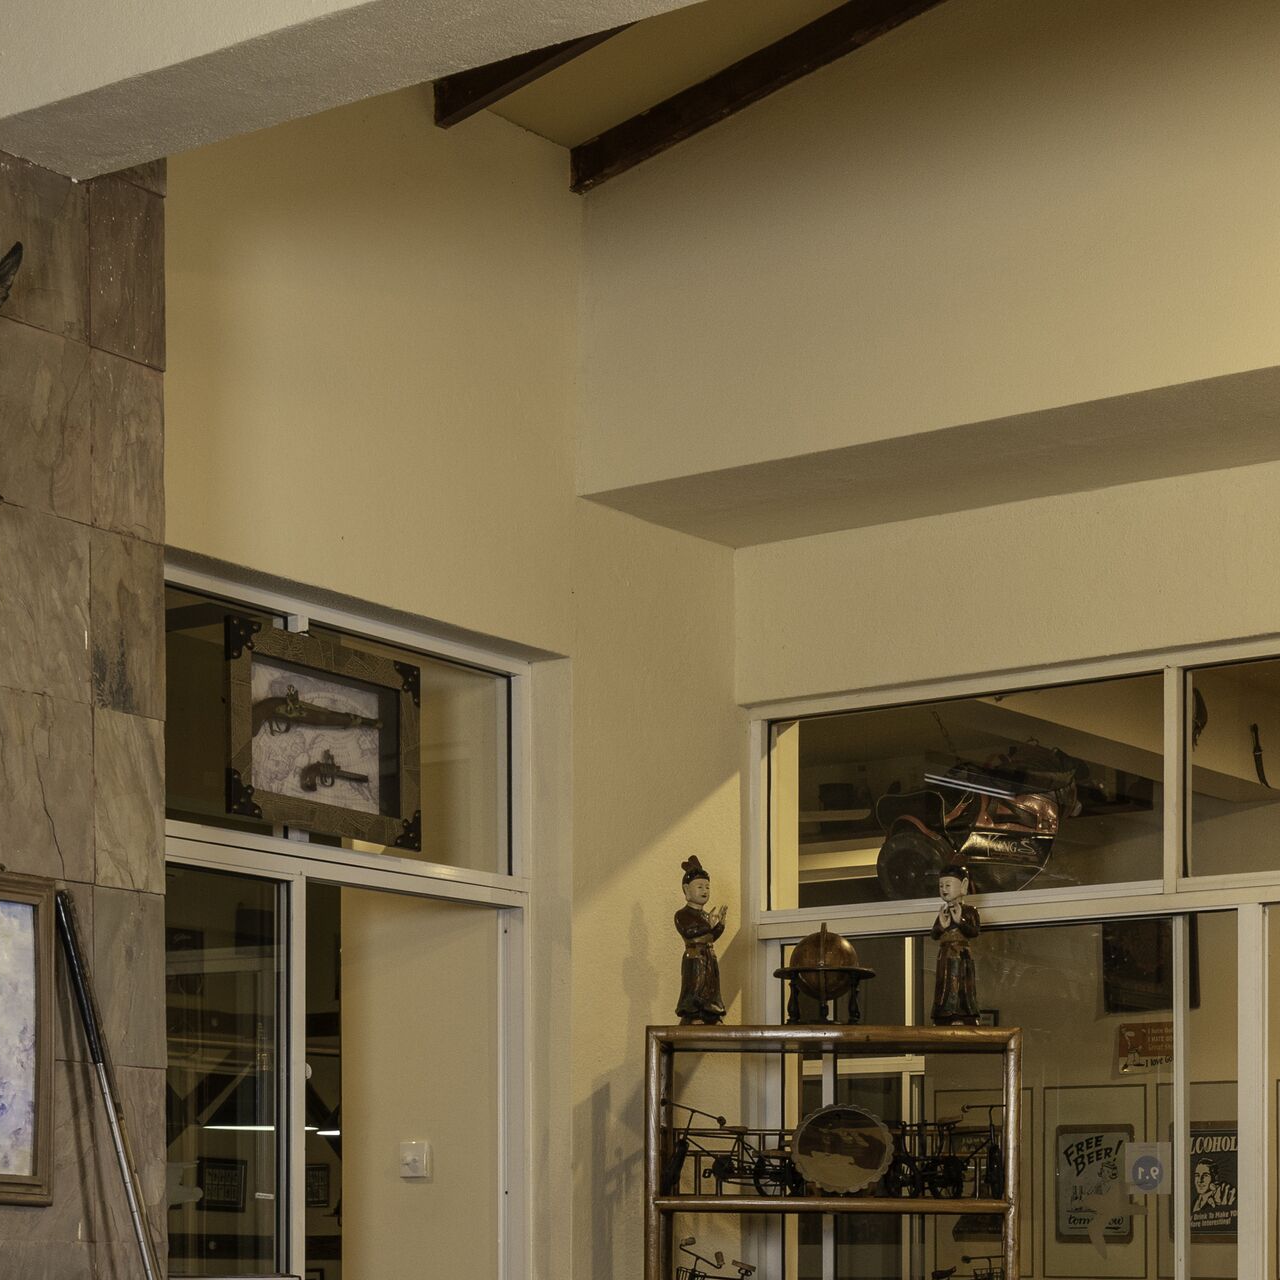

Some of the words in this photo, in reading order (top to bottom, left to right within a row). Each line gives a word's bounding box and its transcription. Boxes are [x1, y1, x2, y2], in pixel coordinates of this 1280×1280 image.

[1164, 1055, 1174, 1064] Go
[1063, 1135, 1104, 1166] FREE
[1190, 1136, 1239, 1155] LCOHOL
[1073, 1140, 1124, 1177] BEER!
[1230, 1209, 1238, 1217] YO
